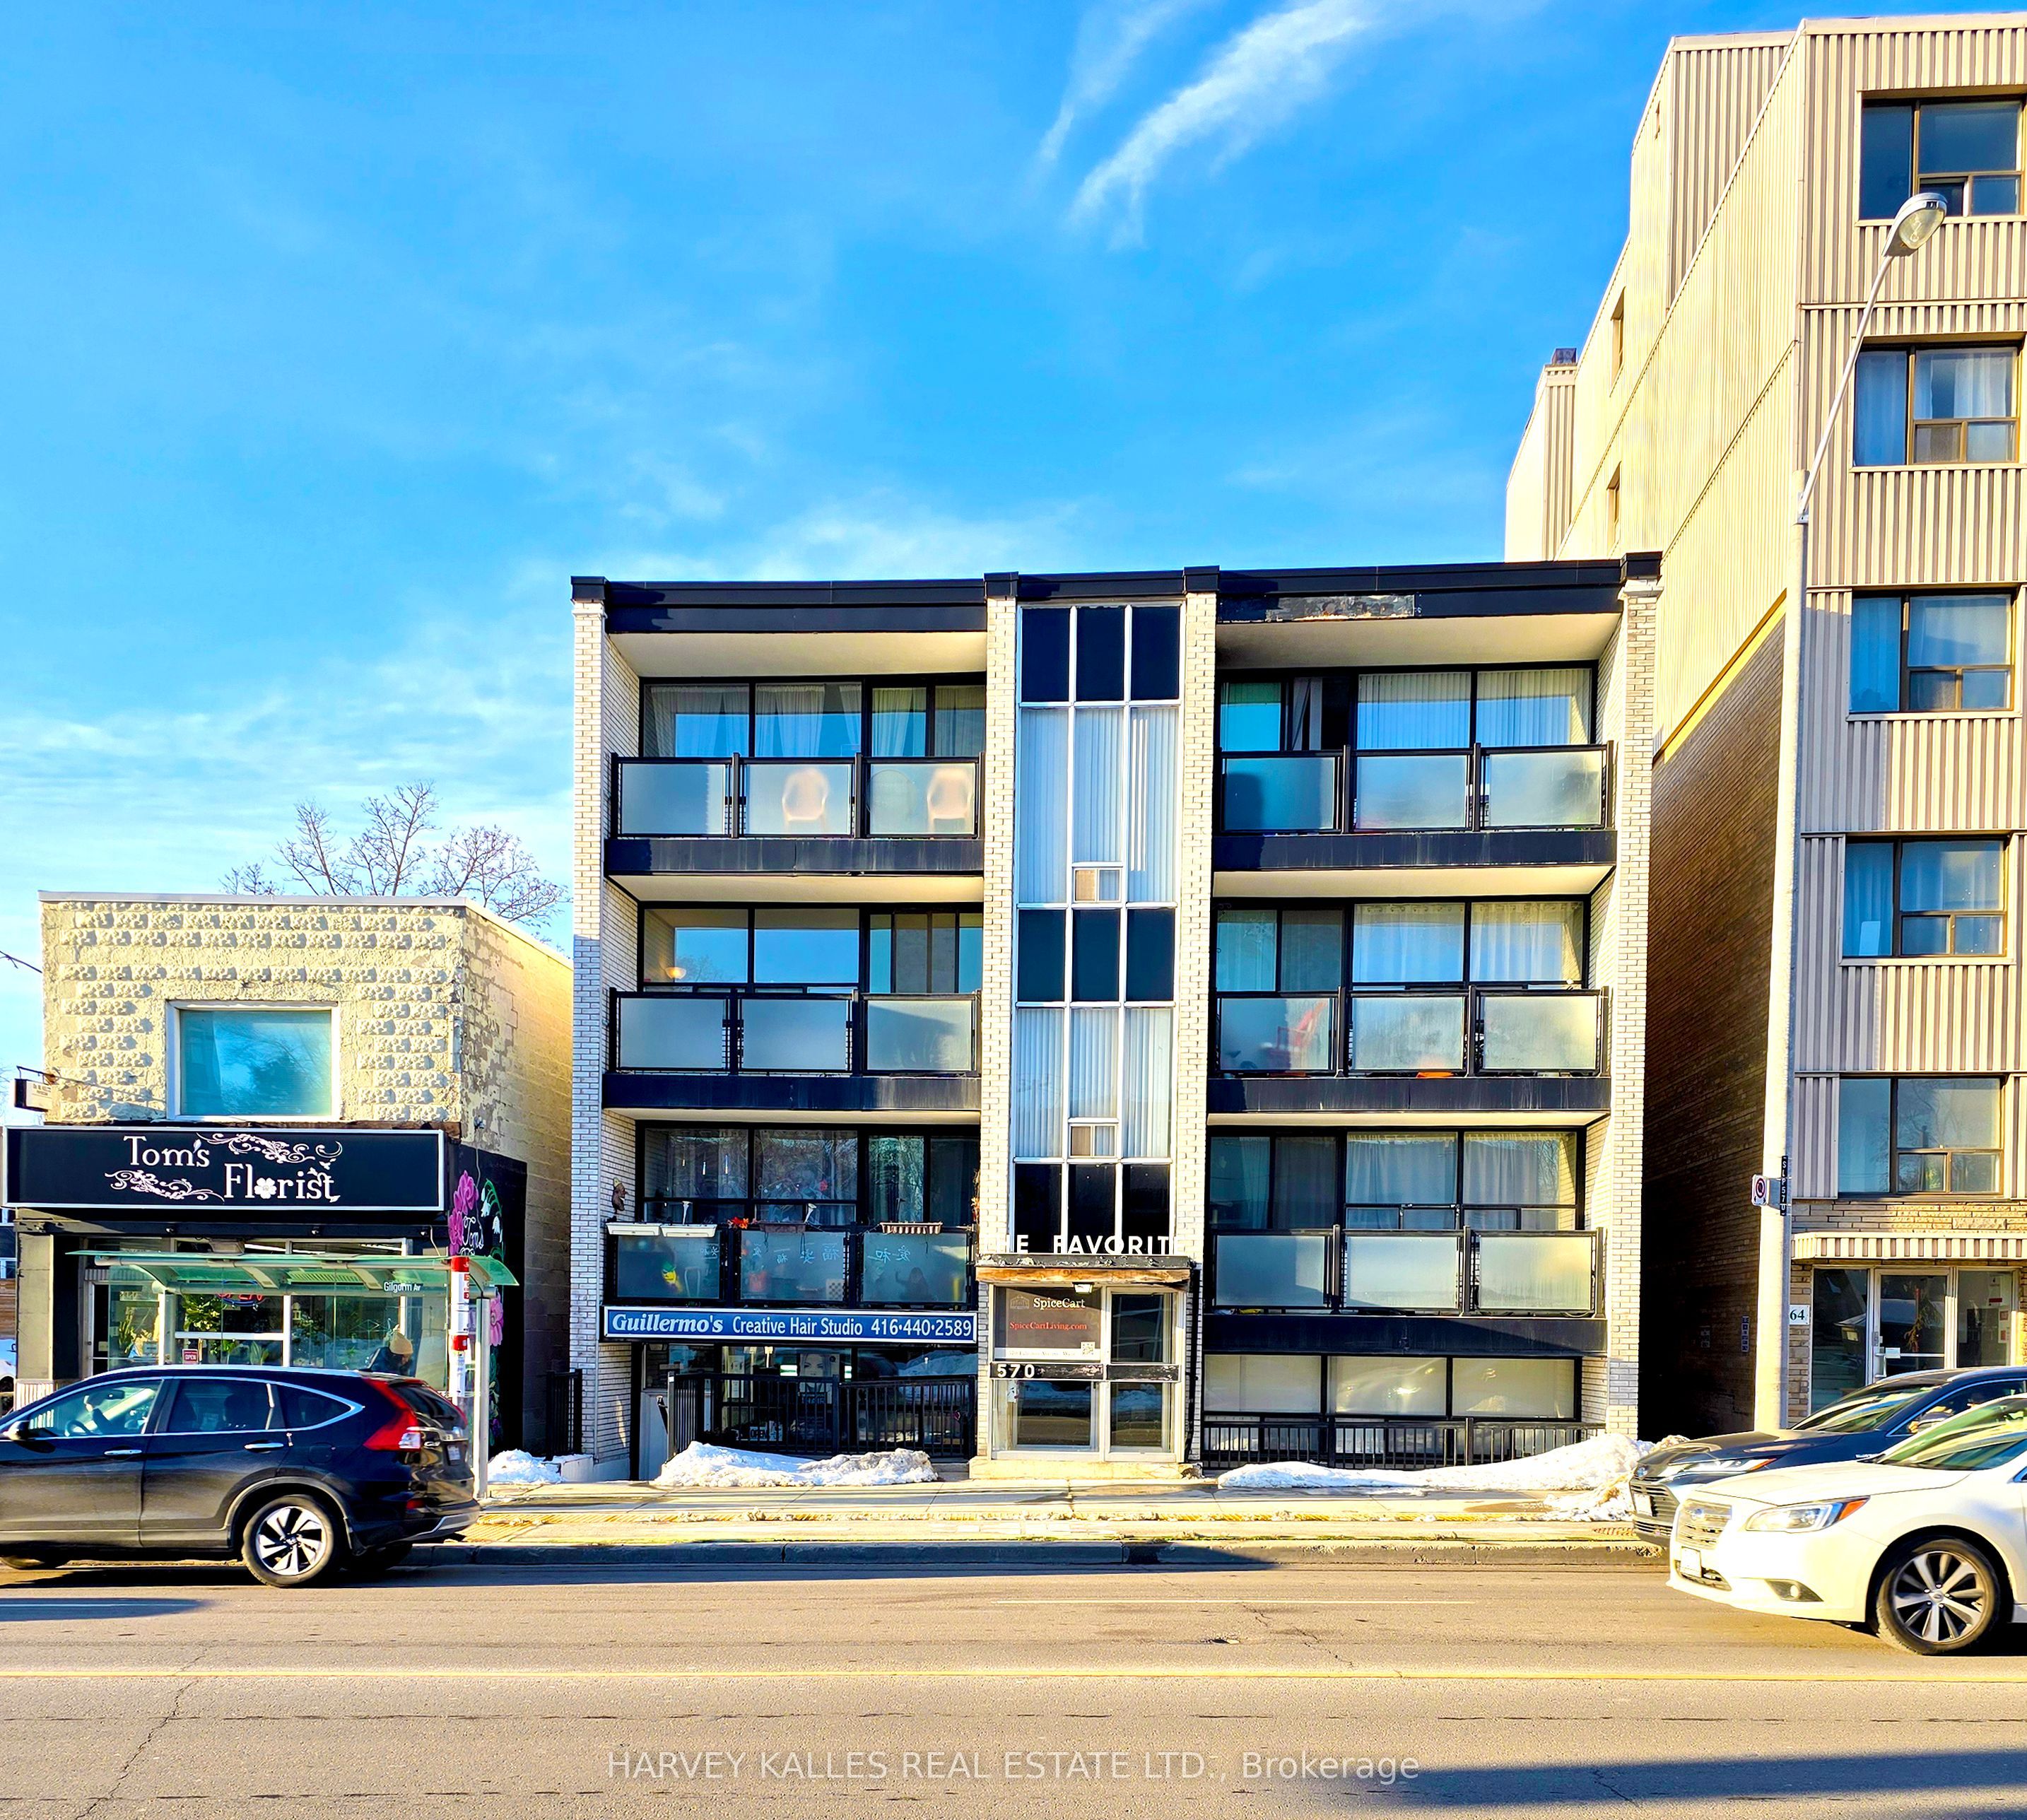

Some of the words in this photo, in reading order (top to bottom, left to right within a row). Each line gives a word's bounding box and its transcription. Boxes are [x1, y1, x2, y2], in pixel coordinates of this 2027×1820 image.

[123, 1135, 210, 1167] Tom's
[384, 1281, 412, 1293] Gilgorm
[1033, 1297, 1086, 1310] SpiceCart
[1790, 1309, 1804, 1320] 64
[612, 1313, 724, 1334] Guillermo's
[732, 1316, 786, 1334] Creative
[790, 1317, 817, 1335] Hair
[821, 1317, 863, 1336] Studio
[1009, 1321, 1087, 1331] SpiceCartLiving.com
[997, 1363, 1035, 1378] 570
